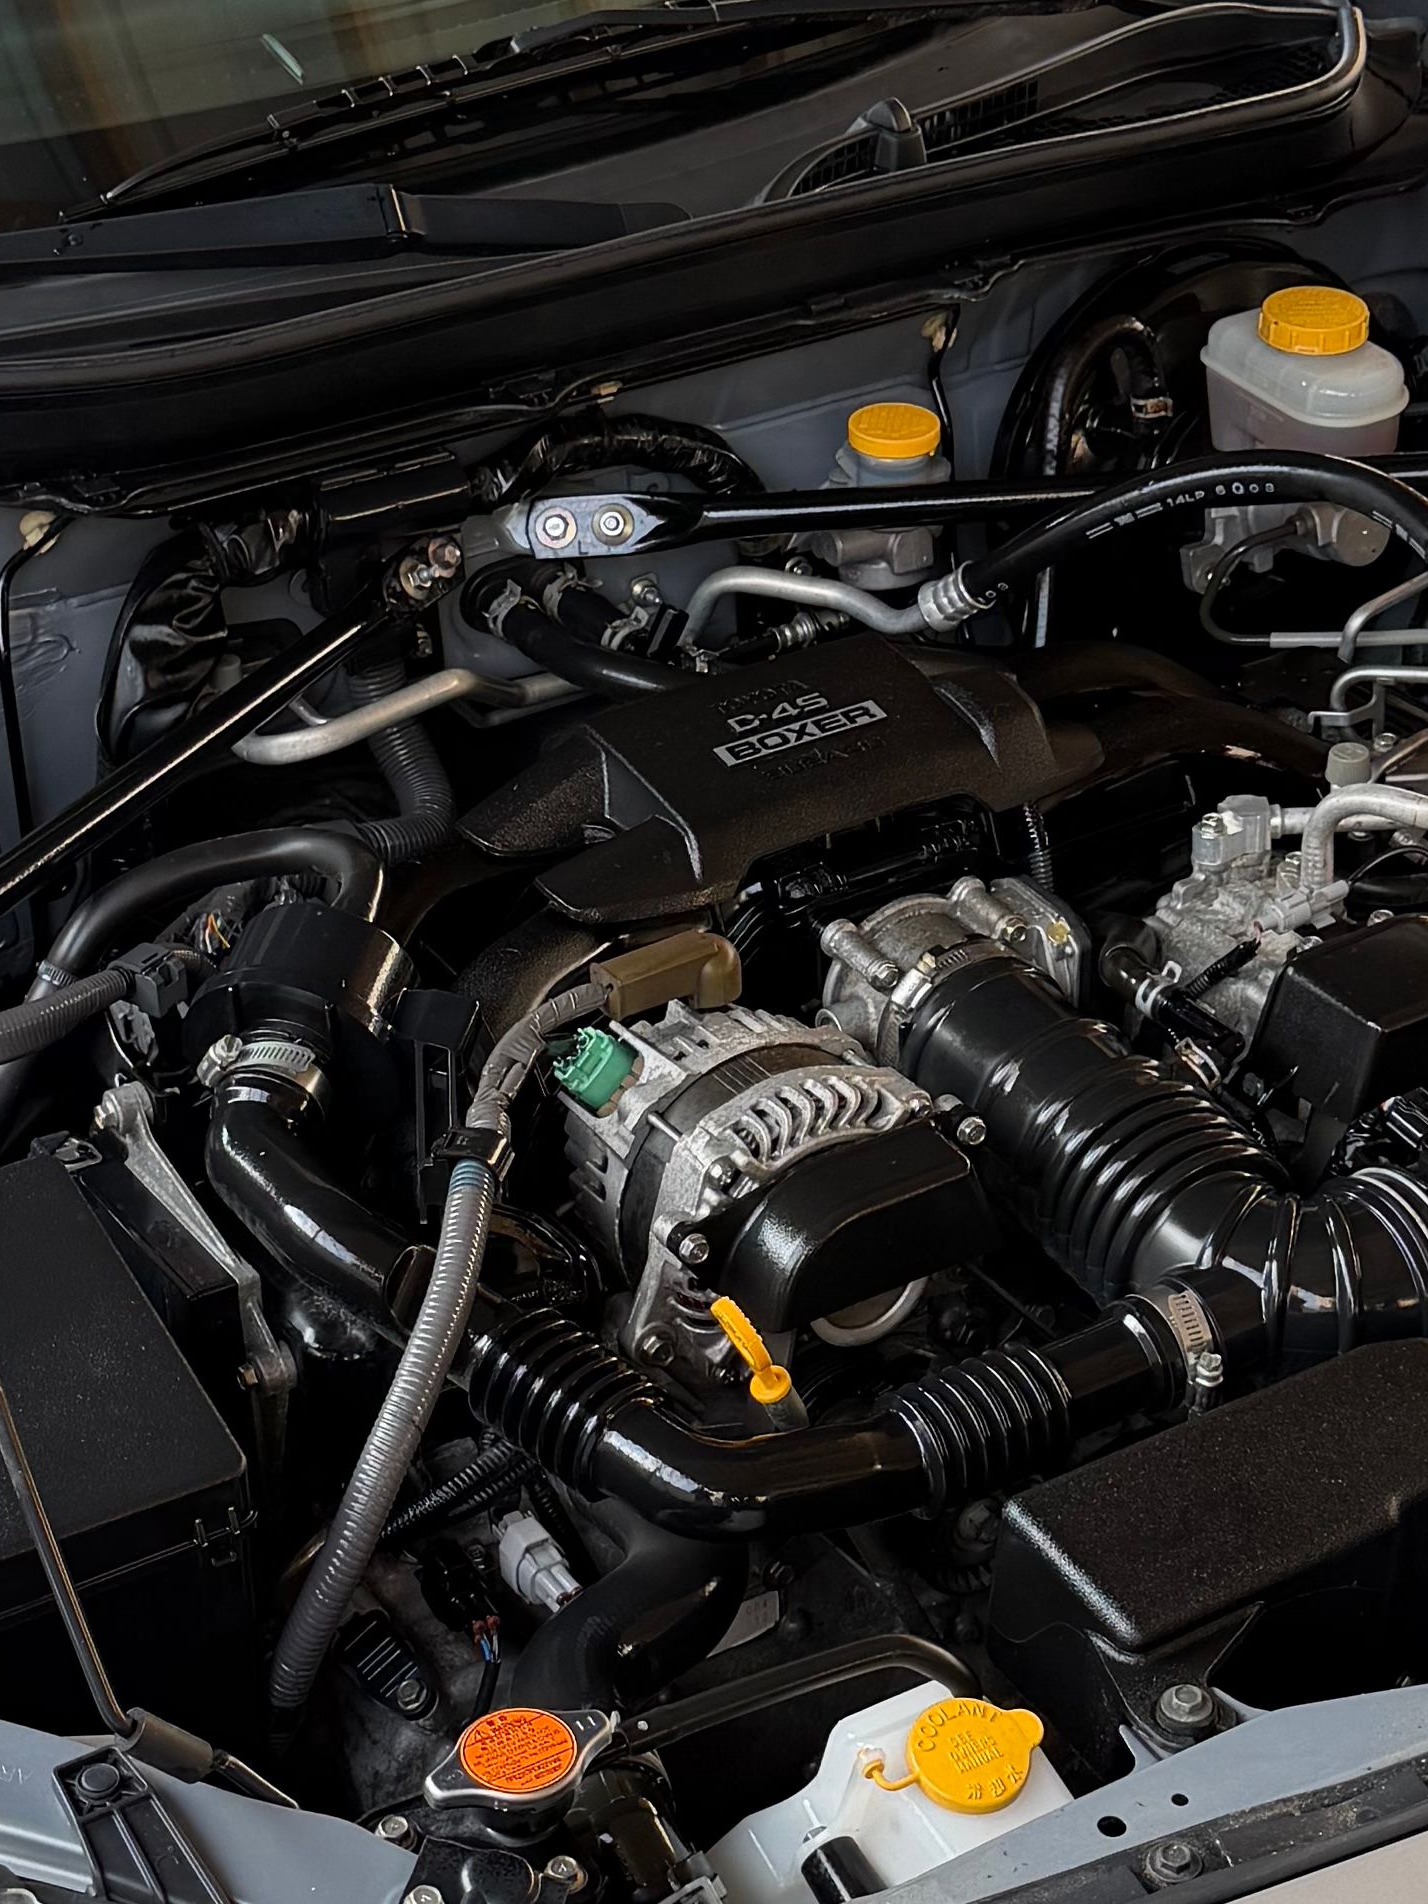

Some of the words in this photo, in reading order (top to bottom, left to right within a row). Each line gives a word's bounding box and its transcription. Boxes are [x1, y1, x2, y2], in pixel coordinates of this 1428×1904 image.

[725, 704, 878, 762] BOXER
[727, 692, 829, 734] D-4S
[917, 1701, 1003, 1752] COOLANT
